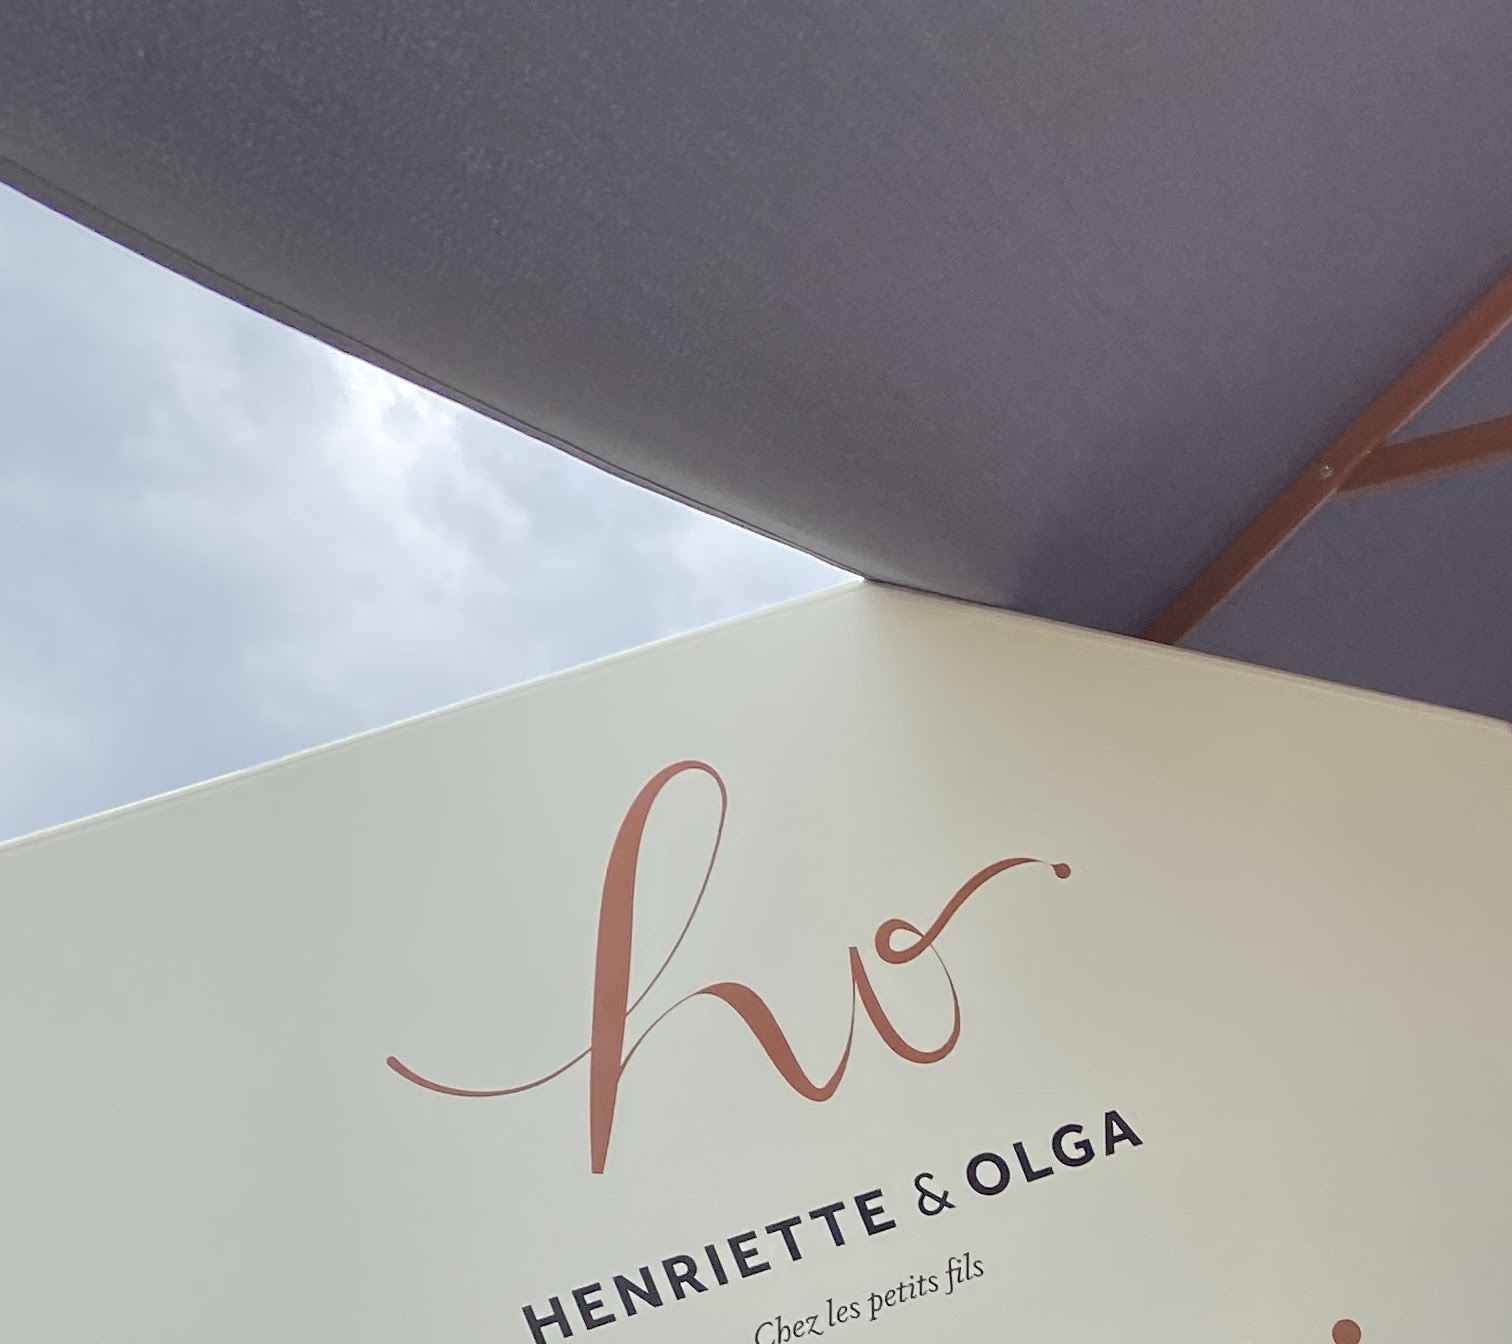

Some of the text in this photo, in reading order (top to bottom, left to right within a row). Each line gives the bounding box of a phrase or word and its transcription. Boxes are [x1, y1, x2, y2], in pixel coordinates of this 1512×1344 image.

[914, 1173, 955, 1217] &
[966, 1110, 1143, 1197] OLGA
[826, 1297, 861, 1328] les
[868, 1272, 939, 1322] petits
[944, 1252, 985, 1296] fils
